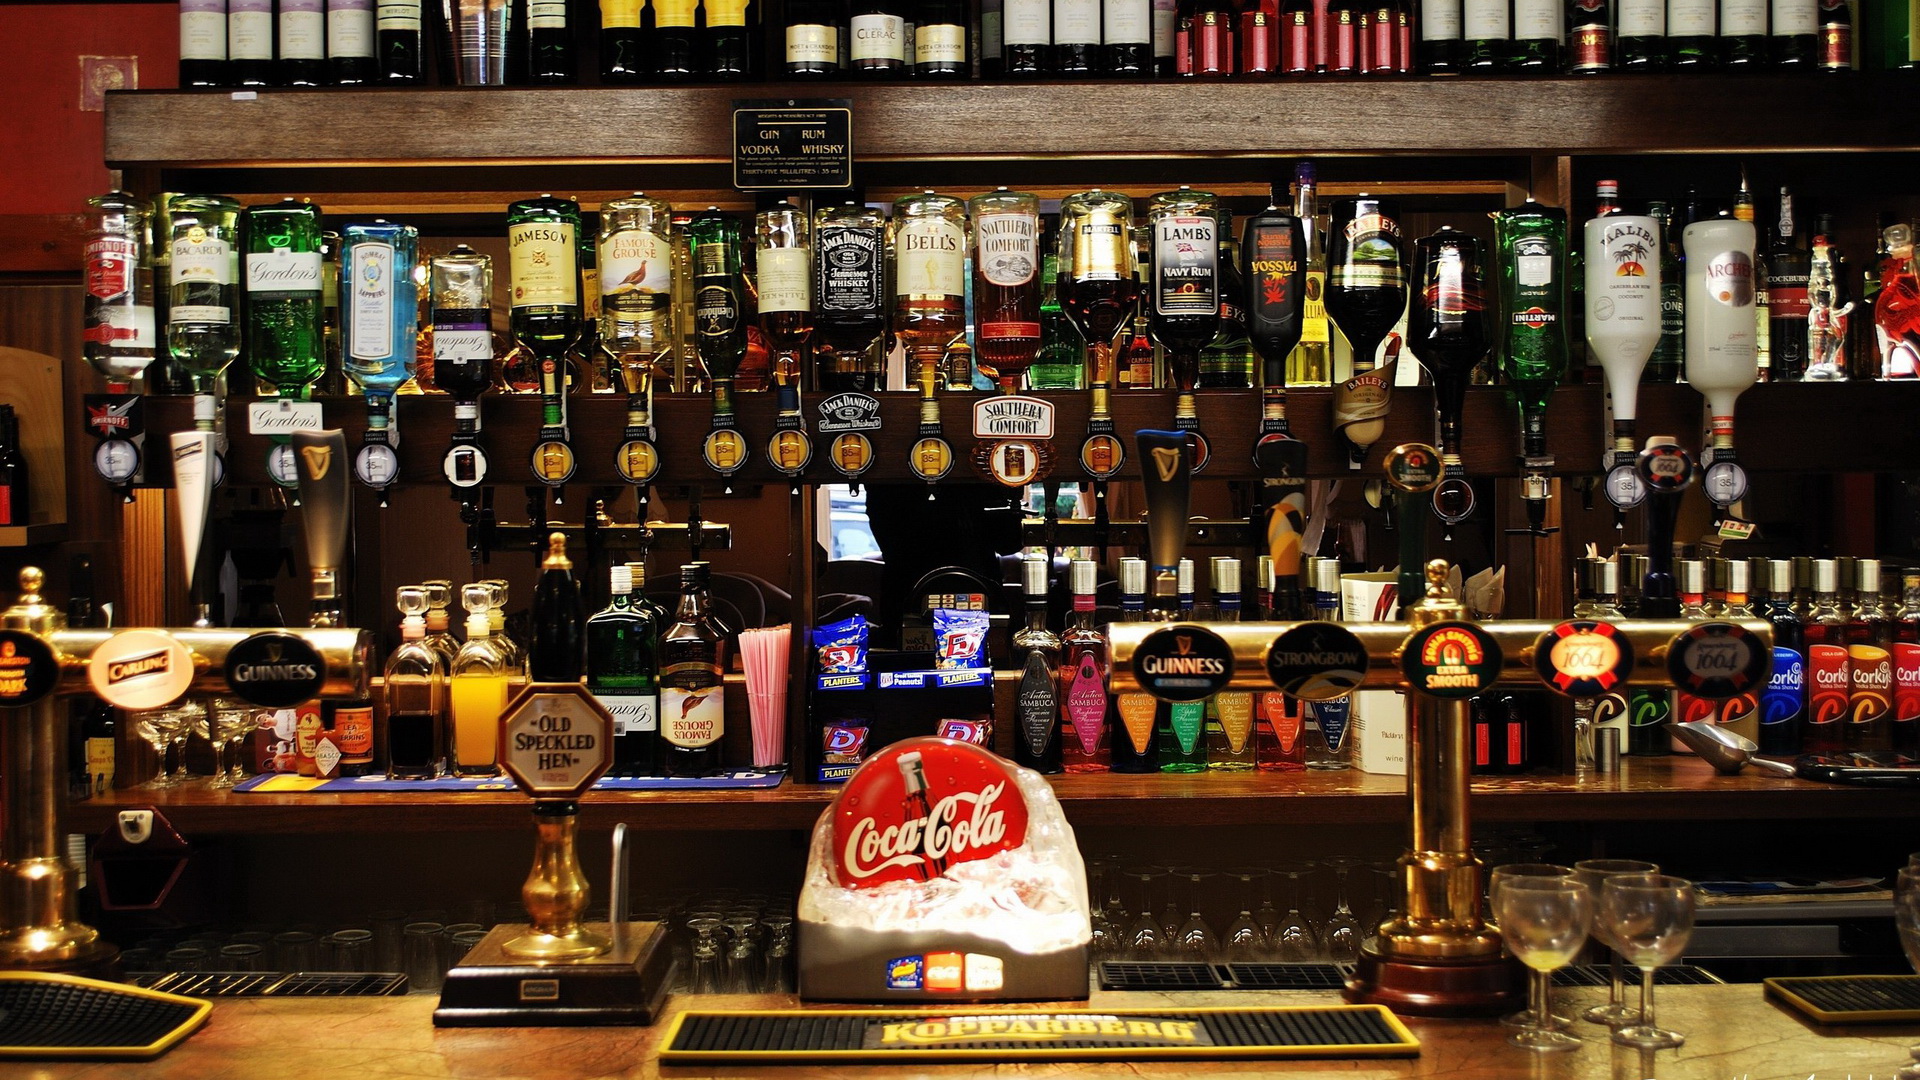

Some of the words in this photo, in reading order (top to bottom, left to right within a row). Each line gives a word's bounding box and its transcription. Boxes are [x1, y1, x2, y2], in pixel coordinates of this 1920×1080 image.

[857, 28, 896, 40] CLERAC
[760, 130, 780, 139] GIN
[802, 130, 825, 139] RUM
[741, 145, 780, 154] VODKA
[802, 144, 844, 154] WHISKY
[980, 219, 1033, 239] SOUTHERN
[1163, 227, 1211, 241] LAMB'S
[513, 229, 567, 247] JAMESON
[615, 238, 655, 248] FAMOUS
[823, 234, 843, 251] JACK
[843, 232, 876, 251] DANIEL'S
[906, 234, 956, 251] BELL'S
[1600, 226, 1656, 248] MALIBU
[176, 246, 222, 256] BACARDI
[986, 238, 1031, 252] COMFORT
[613, 249, 656, 259] GROUSE
[251, 260, 318, 282] Gordon's
[706, 264, 716, 273] 12
[831, 268, 868, 278] Tennessee
[1164, 268, 1190, 277] NAVY
[1191, 266, 1212, 276] RUM
[1708, 262, 1751, 278] ARCHE
[435, 336, 488, 351] Gordon's
[1349, 376, 1387, 389] BAILEYS
[824, 398, 843, 414] JACK
[843, 395, 874, 411] DANIEL'S
[985, 402, 1045, 419] SOUTHERN
[91, 416, 128, 427] SMIRNOFF
[253, 409, 318, 430] Gordon's
[990, 420, 1039, 434] COMFORT
[1656, 462, 1678, 474] 1664
[1425, 632, 1445, 662] JOHN
[1446, 630, 1480, 661] SMITH'S
[1143, 655, 1225, 674] GUINNESS
[1274, 651, 1359, 667] STRONGBOW
[1563, 650, 1604, 669] 1664
[1695, 649, 1737, 669] 1664
[109, 655, 168, 681] CARLING
[235, 663, 317, 682] GUINNESS
[1436, 666, 1469, 674] EXTRA
[1896, 667, 1920, 682] Cork
[824, 676, 860, 687] PLANTERS
[943, 674, 978, 684] PLANTERS
[1426, 674, 1480, 689] SMOOTH
[1022, 690, 1051, 699] Antica
[1072, 690, 1102, 699] Antica
[1074, 709, 1103, 718] Raspberry
[540, 715, 571, 732] OLD
[672, 720, 714, 729] GROUSE
[515, 733, 595, 751] SPECKLED
[674, 731, 711, 739] FAMOUS
[538, 753, 572, 770] HEN
[825, 769, 856, 778] PLANTE
[844, 780, 1008, 878] Coca-Cola
[882, 1020, 1197, 1044] KOPPARBERG
